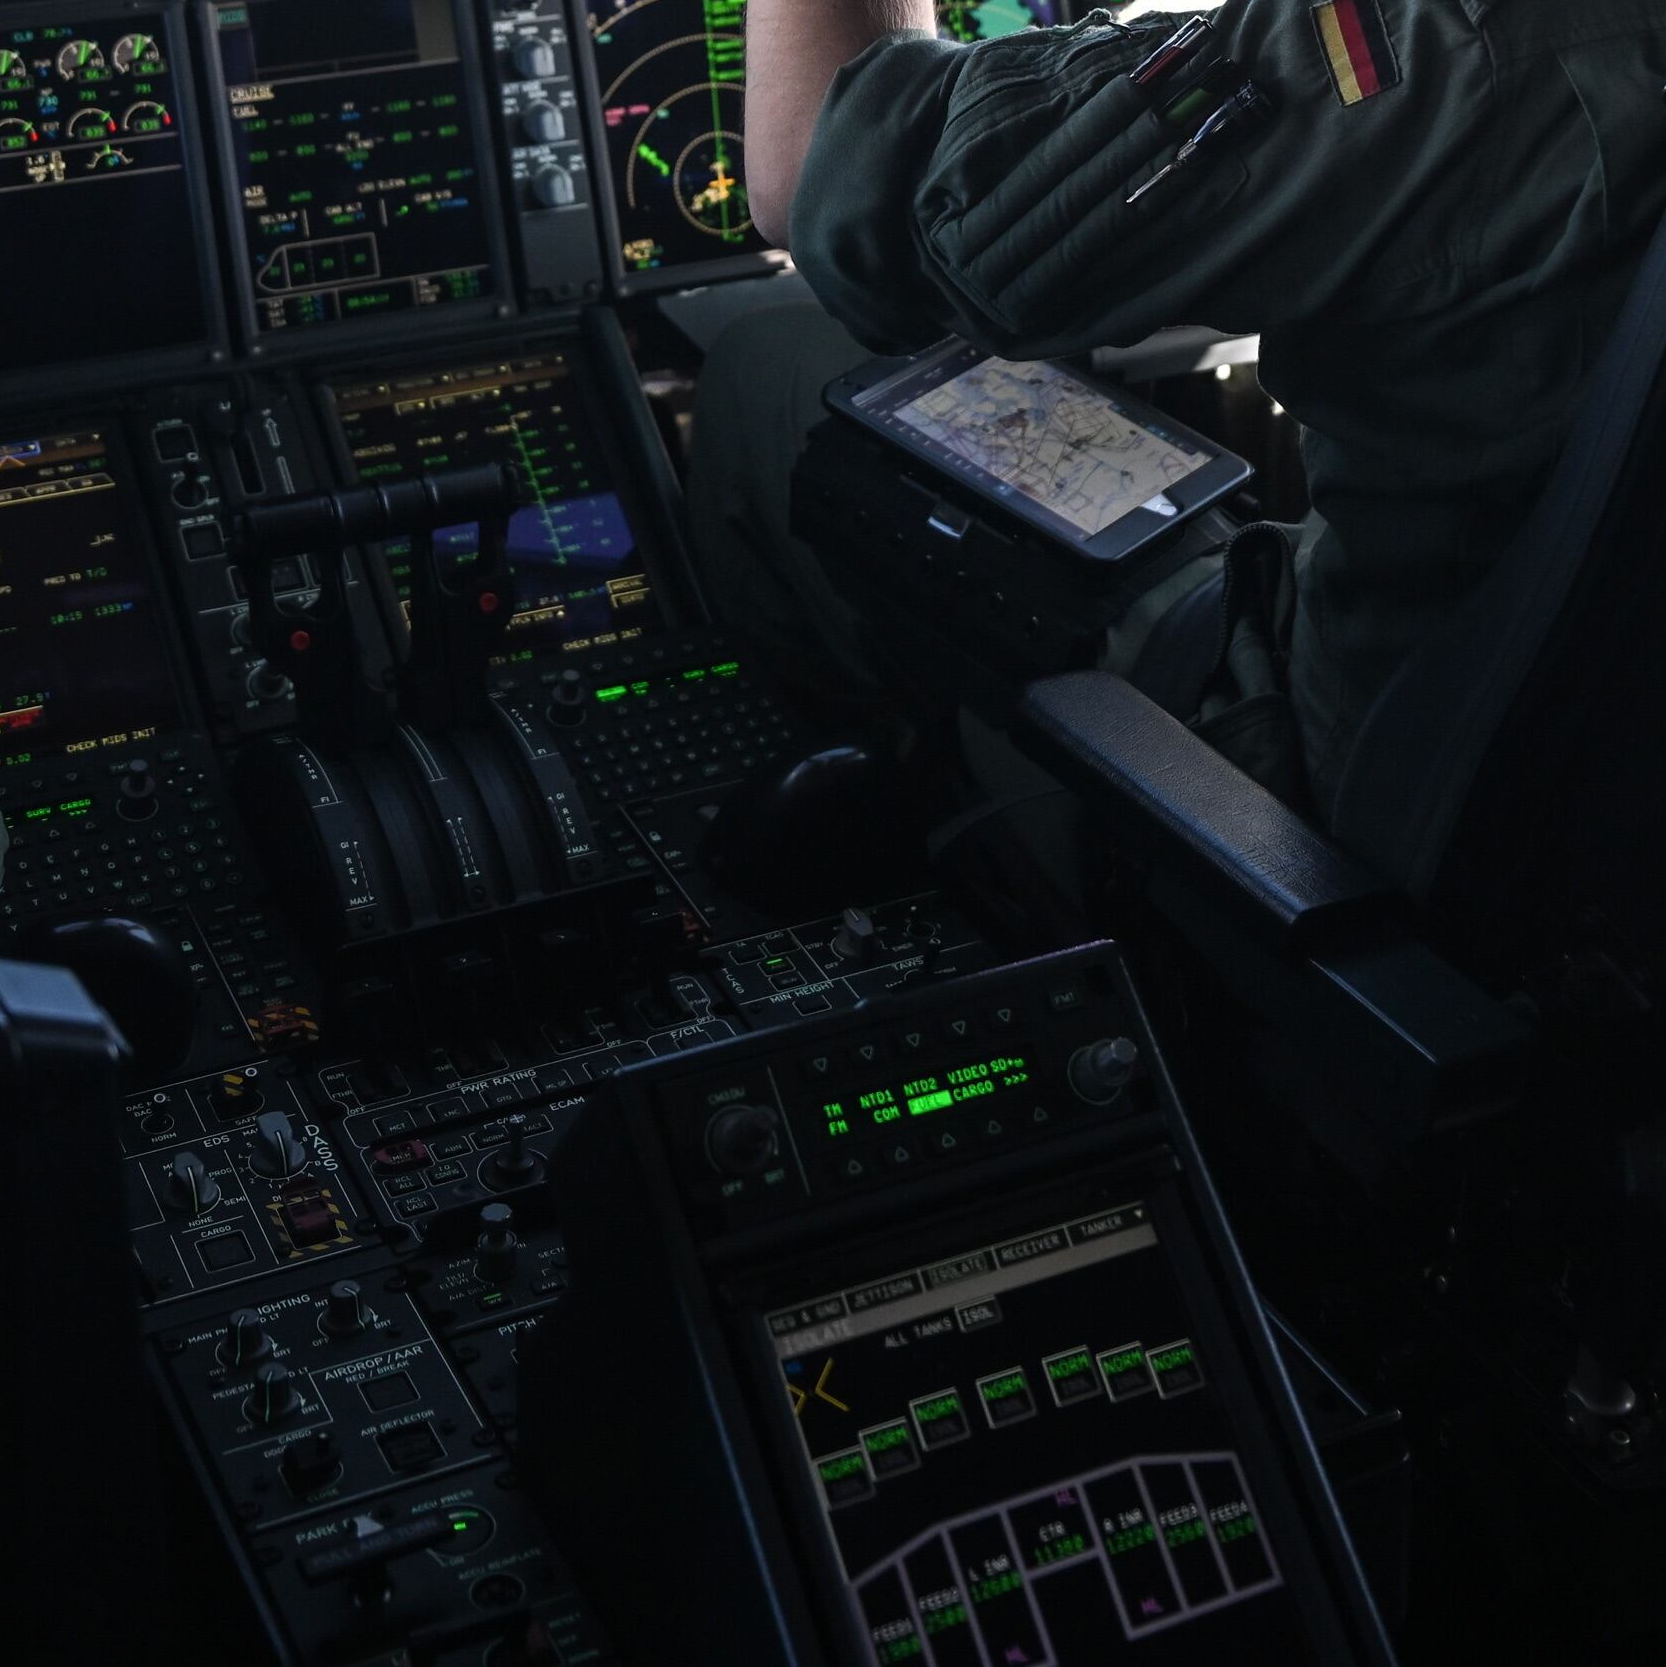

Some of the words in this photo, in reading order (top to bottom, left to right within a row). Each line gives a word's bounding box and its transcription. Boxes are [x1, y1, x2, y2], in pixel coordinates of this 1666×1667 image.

[65, 740, 98, 753] CHECK
[102, 733, 127, 746] MIDS
[132, 726, 157, 740] INIT
[349, 896, 368, 906] MAX
[769, 991, 791, 1004] MIN
[795, 981, 833, 998] HEIGHT
[460, 1079, 490, 1095] PWR
[493, 1069, 537, 1090] RATING
[859, 1090, 896, 1109] NTD1
[903, 1078, 938, 1097] NTD2
[947, 1064, 989, 1084] VIDEO
[953, 1080, 996, 1102] CARGO
[549, 1095, 586, 1112] ECAM
[873, 1105, 902, 1124] COM
[203, 1134, 230, 1149] EDS
[200, 1224, 232, 1238] CARGO
[1080, 1214, 1124, 1236] TANKER
[1001, 1233, 1061, 1262] RECEIVER
[884, 1334, 910, 1349] ALL
[914, 1316, 954, 1341] TANKS
[962, 1305, 994, 1325] ISOL
[323, 1356, 383, 1380] AIRDROP
[393, 1345, 423, 1362] AAR
[1149, 1345, 1195, 1373] NORM
[360, 1426, 378, 1437] AIR
[380, 1410, 435, 1433] DEFLECTOR
